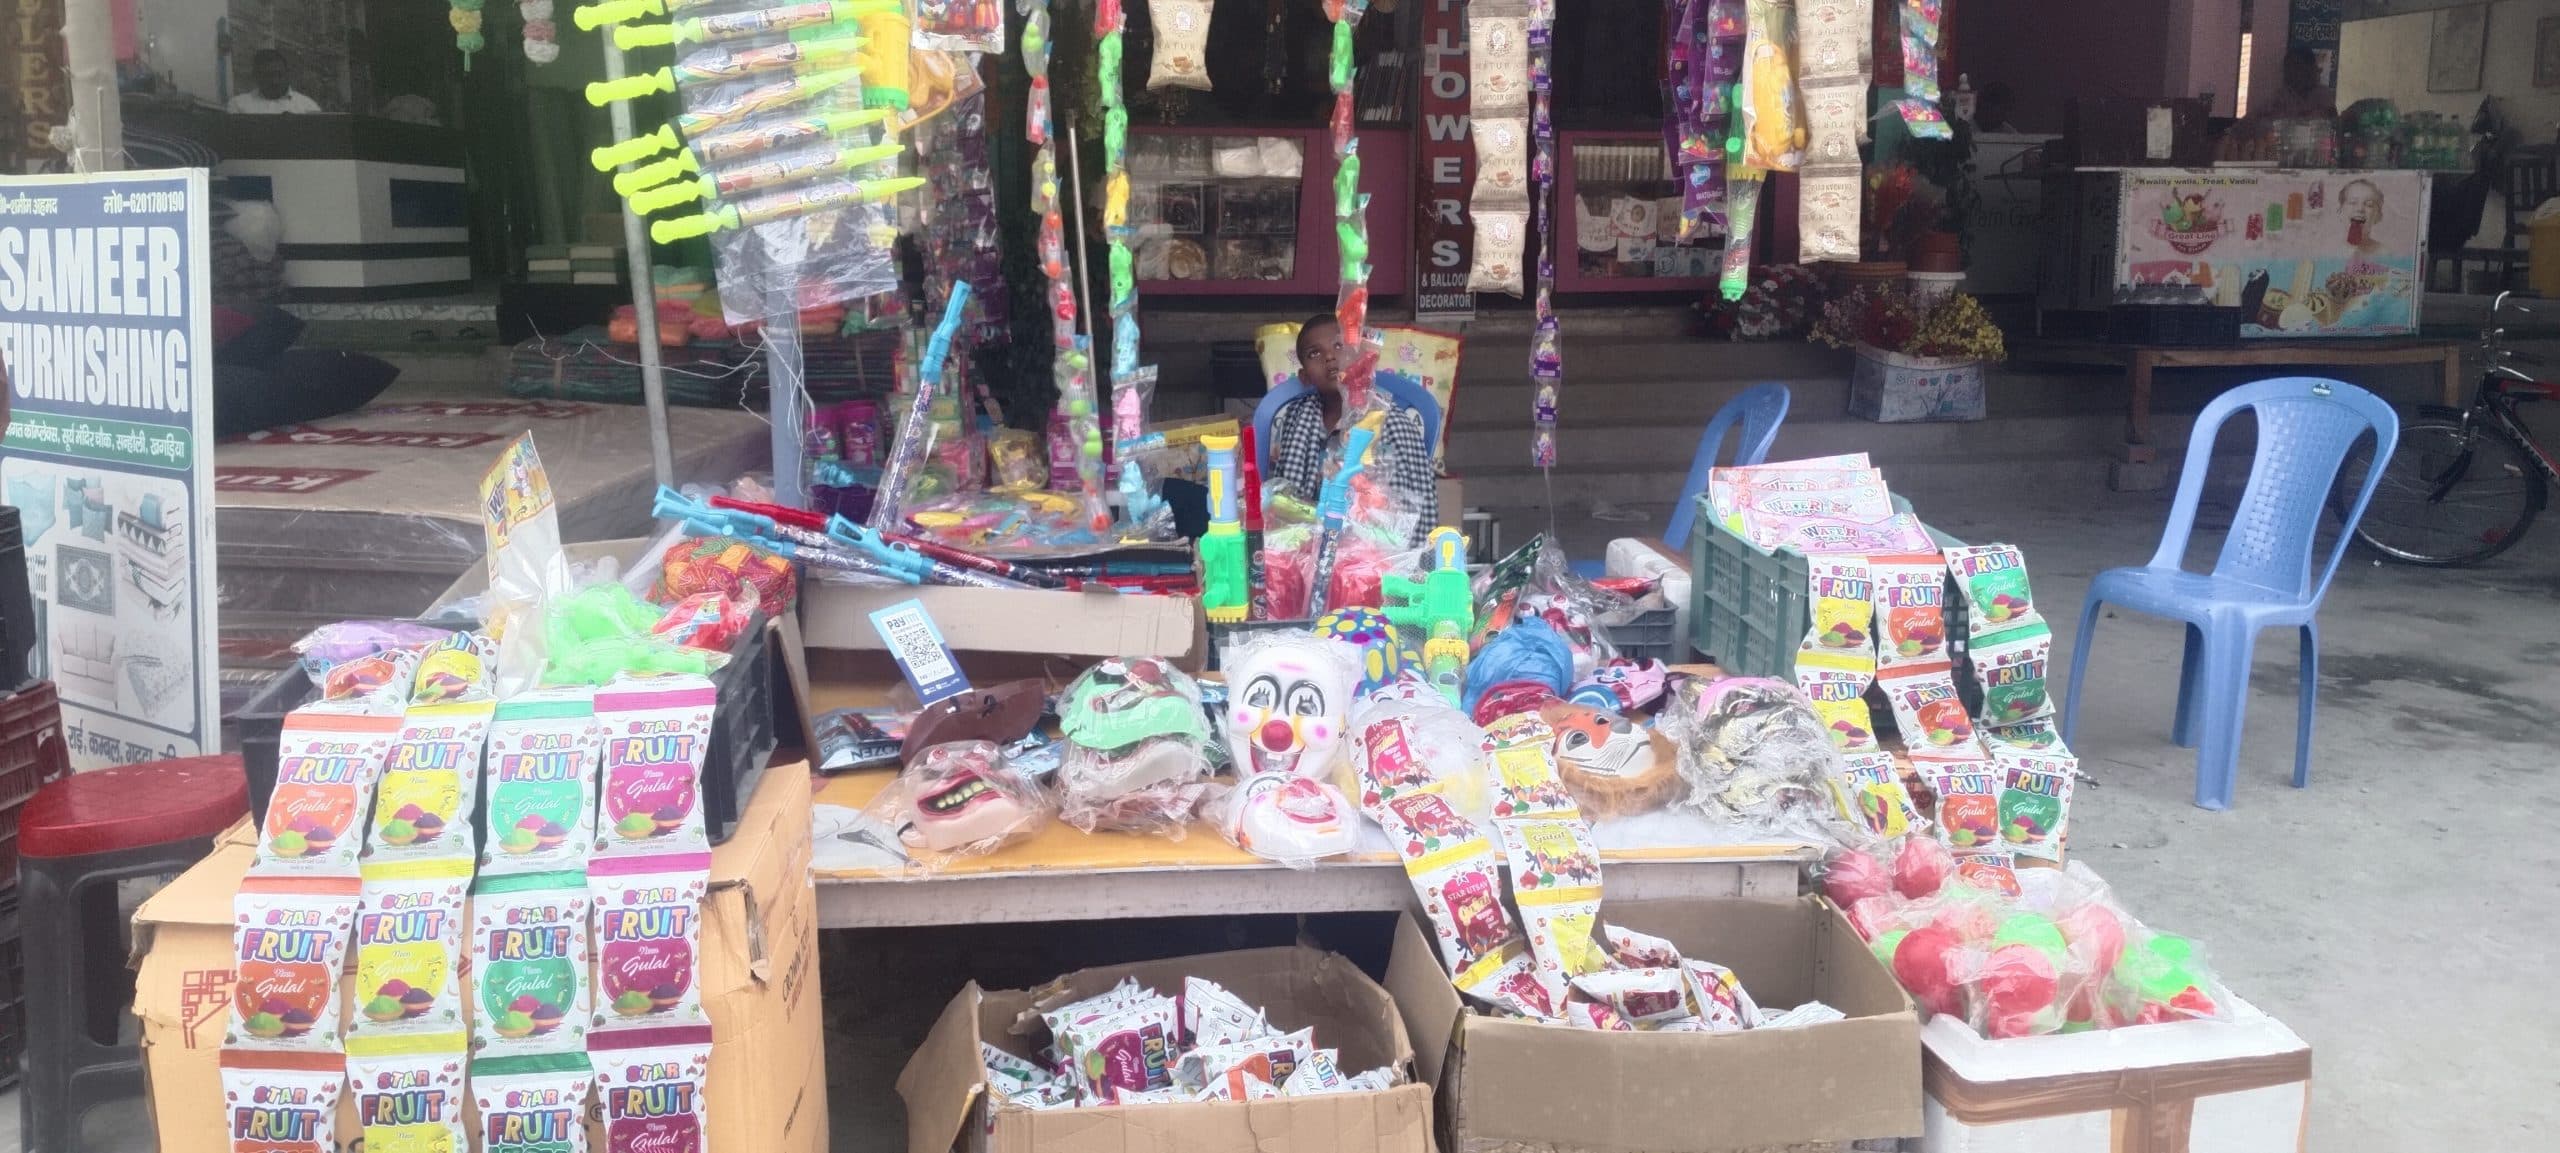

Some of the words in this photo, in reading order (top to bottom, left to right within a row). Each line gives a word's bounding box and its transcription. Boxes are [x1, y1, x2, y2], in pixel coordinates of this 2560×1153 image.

[0, 226, 182, 317] SAMEER
[1420, 293, 1471, 308] DECORATOR
[0, 322, 188, 413] FURNISHING
[1963, 552, 2020, 576] FRUIT
[1820, 577, 1873, 601] FRUIT
[1888, 586, 1941, 607] FRUIT
[1904, 617, 1936, 630] Gulal
[1987, 659, 2045, 687] FRUIT
[1810, 682, 1865, 701] FRUIT
[403, 727, 455, 741] STAR
[628, 720, 682, 734] STAR
[306, 742, 359, 754] STAR
[521, 734, 572, 749] STAR
[609, 735, 695, 766] FRUIT
[384, 742, 465, 771] FRUIT
[500, 750, 584, 782] FRUIT
[2019, 758, 2056, 773] STAR
[279, 756, 366, 785] FRUIT
[627, 777, 675, 798] Gulal
[1937, 775, 1994, 796] FRUIT
[2005, 768, 2064, 797] FRUIT
[287, 797, 336, 816] Gulal
[515, 797, 560, 813] Gulal
[1957, 805, 1988, 818] Gulal
[2012, 802, 2045, 816] Gulal
[380, 892, 433, 909] STAR
[623, 888, 676, 905] STAR
[265, 910, 321, 926] STAR
[506, 906, 557, 925] STAR
[604, 905, 691, 941] FRUIT
[361, 910, 446, 945] FRUIT
[241, 928, 332, 963] FRUIT
[489, 926, 571, 961] FRUIT
[622, 954, 670, 976] Gulal
[256, 978, 305, 998] Gulal
[505, 975, 553, 997] Gulal
[1117, 1049, 1135, 1083] Gulal
[1139, 1022, 1172, 1090] FRUIT
[377, 1070, 430, 1089] STAR
[626, 1063, 680, 1082] STAR
[253, 1085, 307, 1105] STAR
[505, 1089, 558, 1108] STAR
[609, 1082, 695, 1119] FRUIT
[362, 1091, 446, 1126] FRUIT
[234, 1106, 320, 1141] FRUIT
[488, 1109, 572, 1144] FRUIT
[631, 1131, 678, 1153] Gulal
